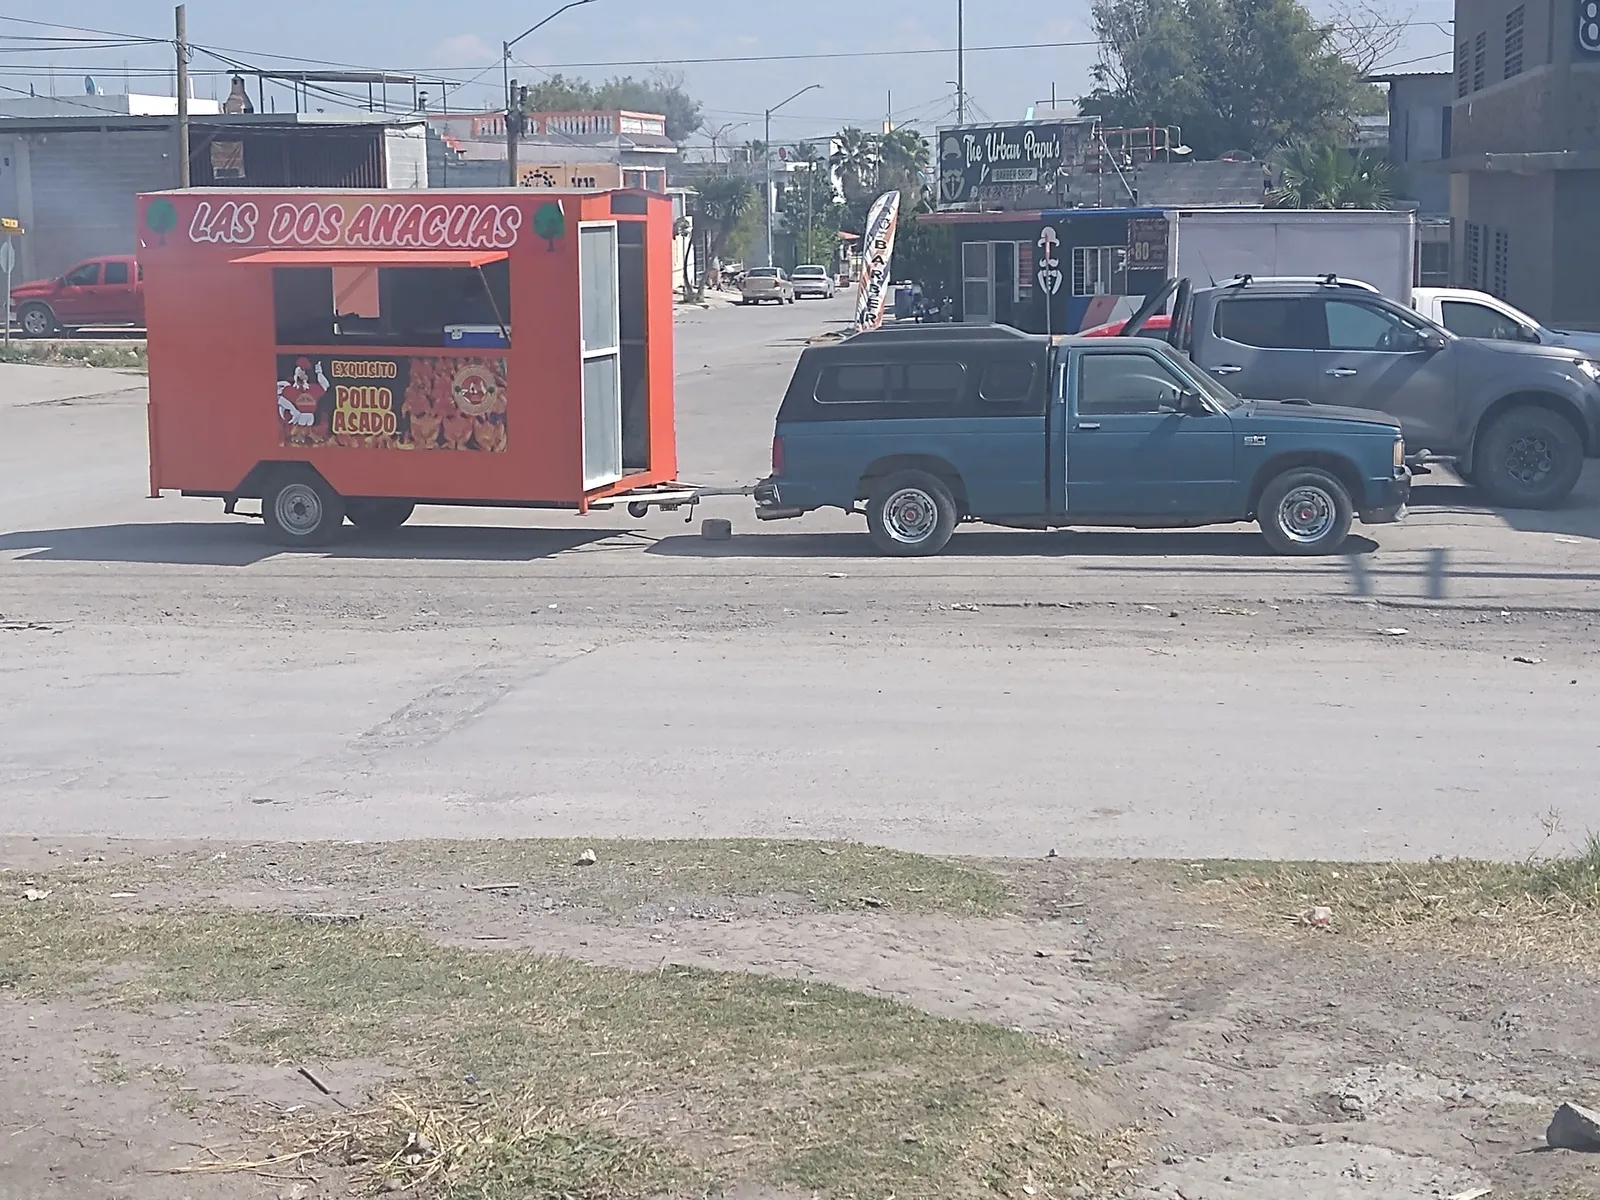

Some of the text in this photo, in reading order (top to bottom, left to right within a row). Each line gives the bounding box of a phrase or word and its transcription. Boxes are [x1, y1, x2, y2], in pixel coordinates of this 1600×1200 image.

[963, 130, 1060, 168] The Urban Papu's
[188, 201, 522, 248] LAS DOS ANACUAS
[865, 239, 888, 324] BARBER
[332, 360, 396, 378] EXQUISITO
[336, 385, 393, 411] POLLO
[332, 409, 397, 435] ASADO
